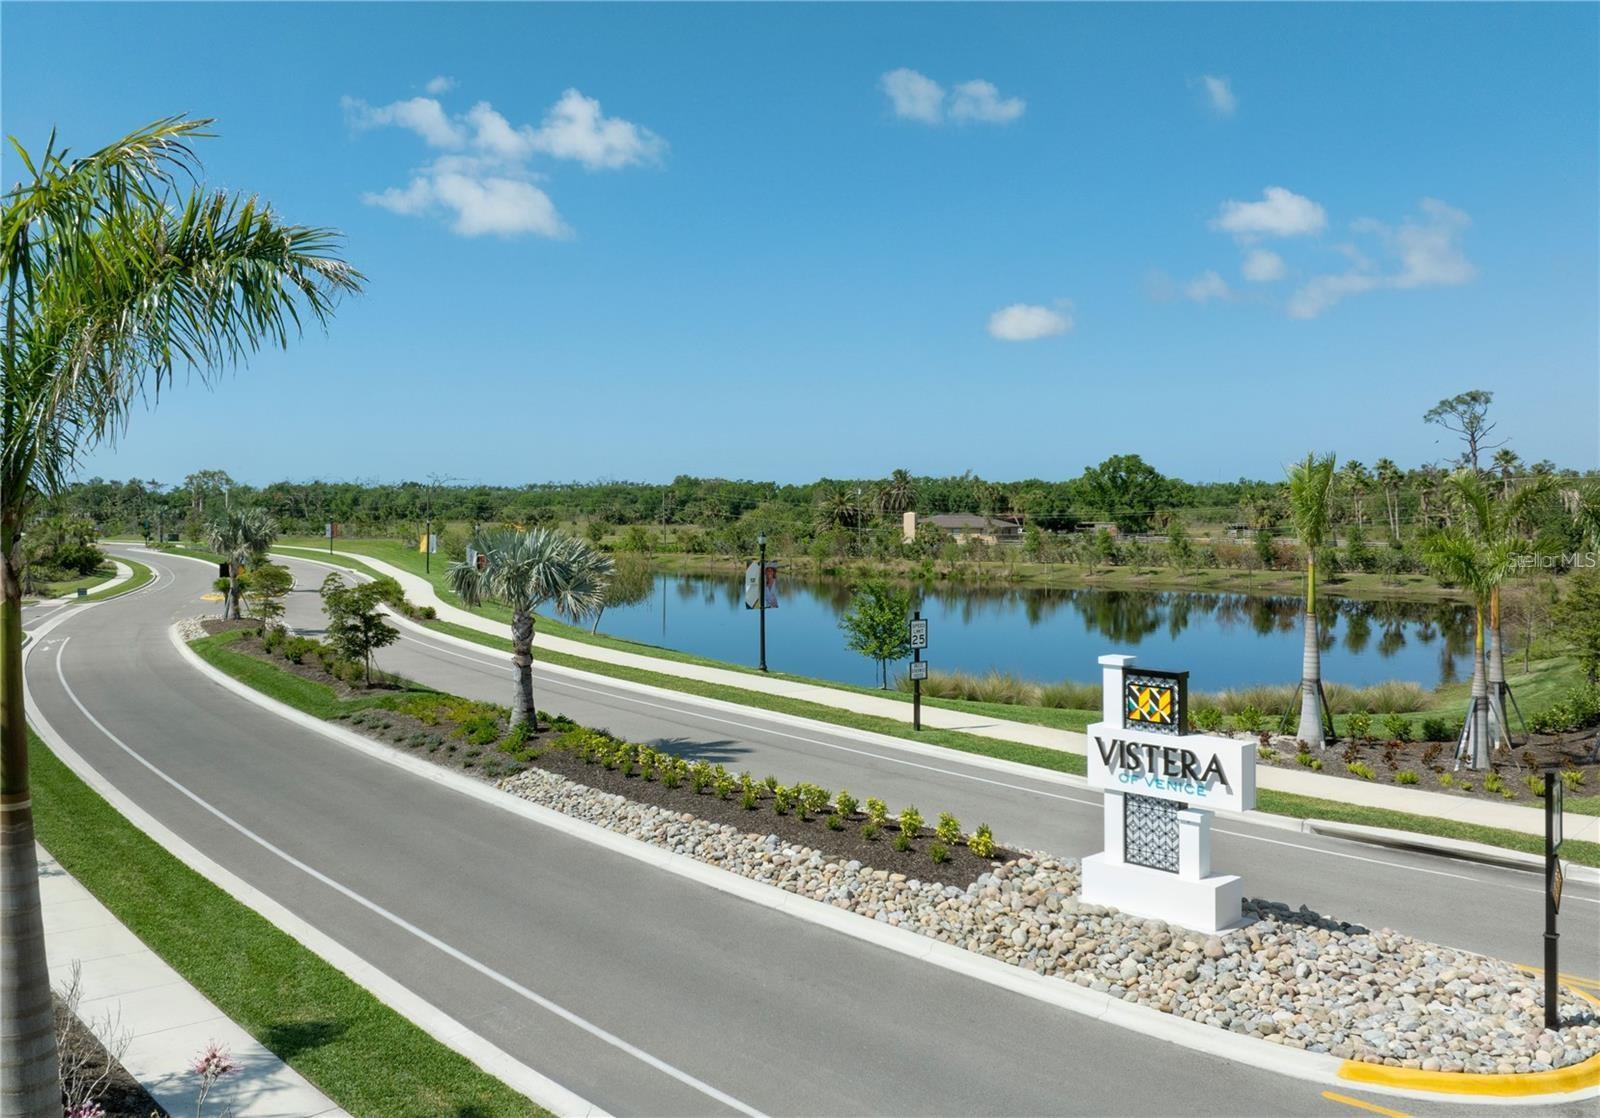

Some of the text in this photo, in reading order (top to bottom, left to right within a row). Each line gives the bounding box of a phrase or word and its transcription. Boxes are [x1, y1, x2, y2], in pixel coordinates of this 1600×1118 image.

[912, 634, 925, 645] 25
[1095, 736, 1229, 786] VISTERA
[1118, 771, 1207, 797] OF VENICE
